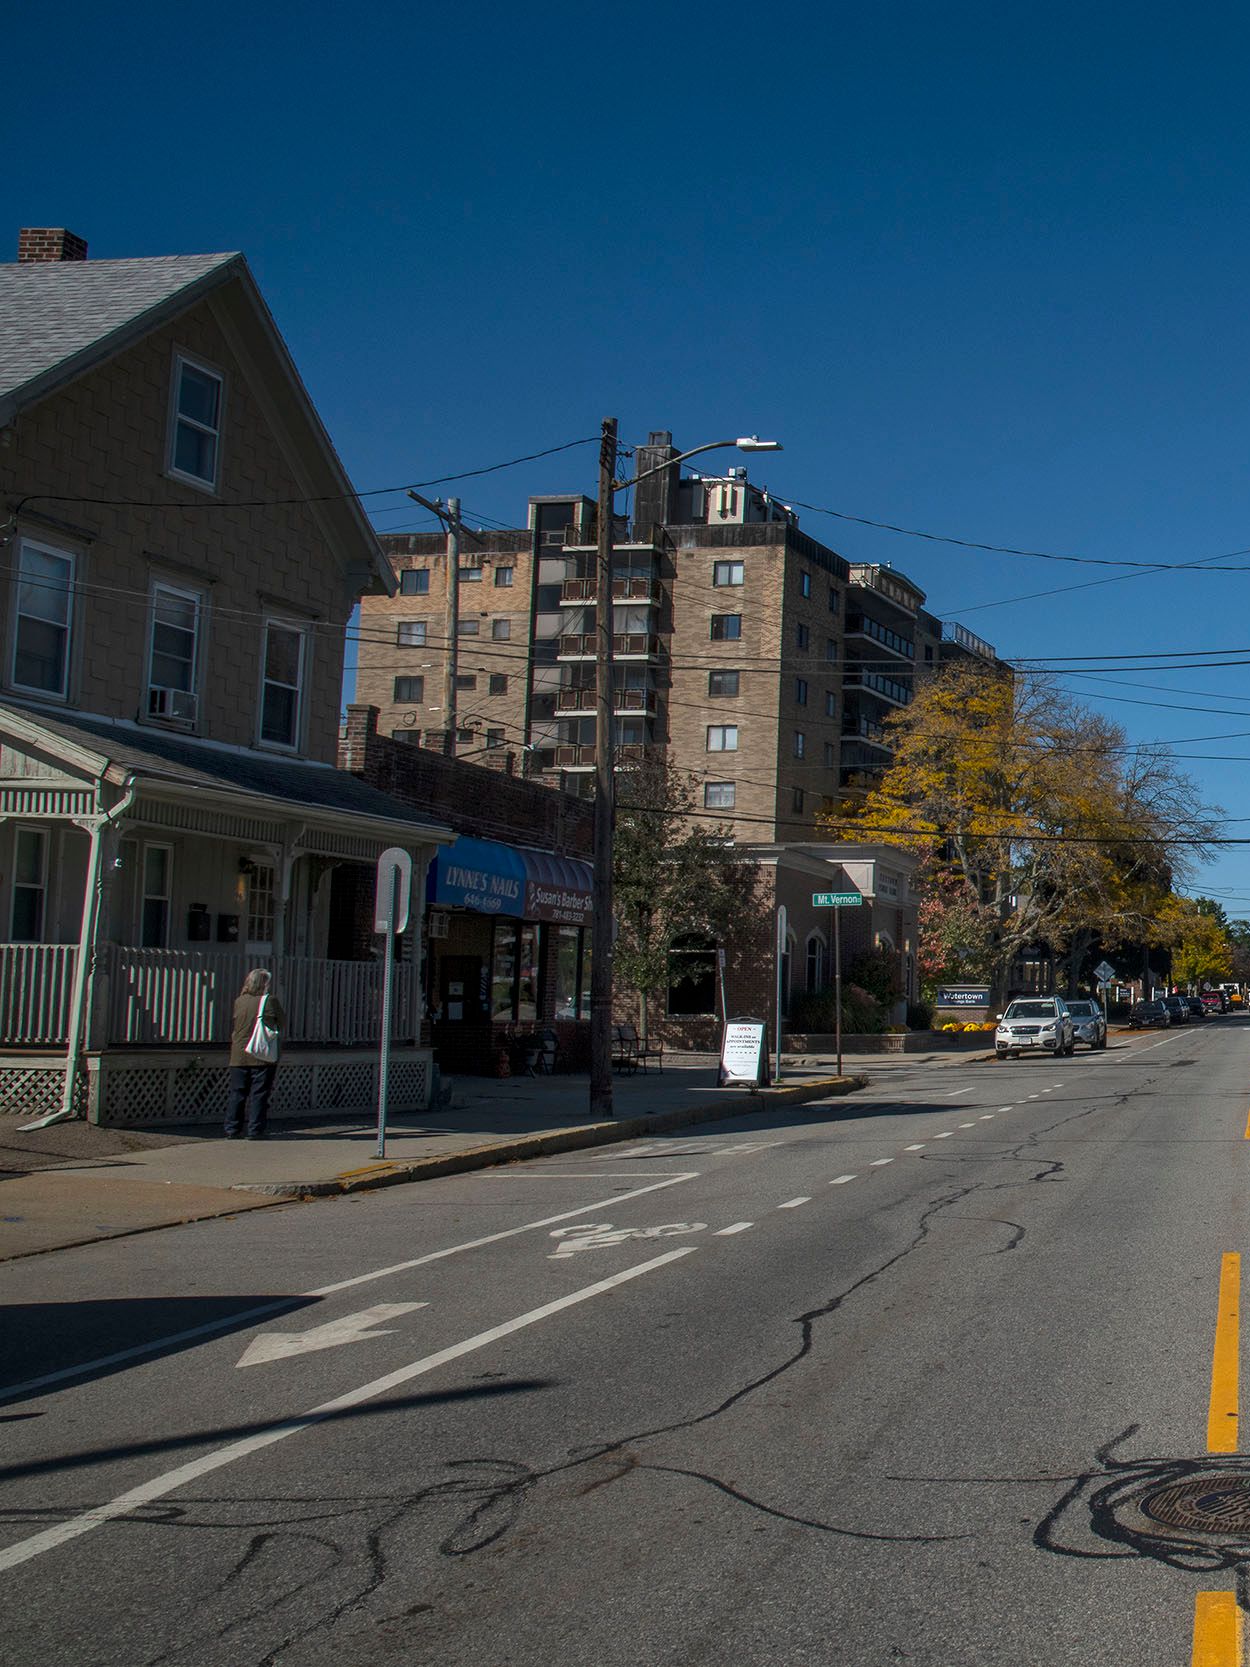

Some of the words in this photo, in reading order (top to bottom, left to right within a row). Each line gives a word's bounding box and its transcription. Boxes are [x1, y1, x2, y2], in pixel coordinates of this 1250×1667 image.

[446, 866, 487, 892] LYNNE'S
[490, 877, 520, 898] NAILS
[536, 887, 560, 907] Susan's
[561, 891, 584, 910] Barber
[817, 896, 830, 904] Mt.
[831, 895, 858, 904] Vernon
[943, 992, 983, 1000] Watertown
